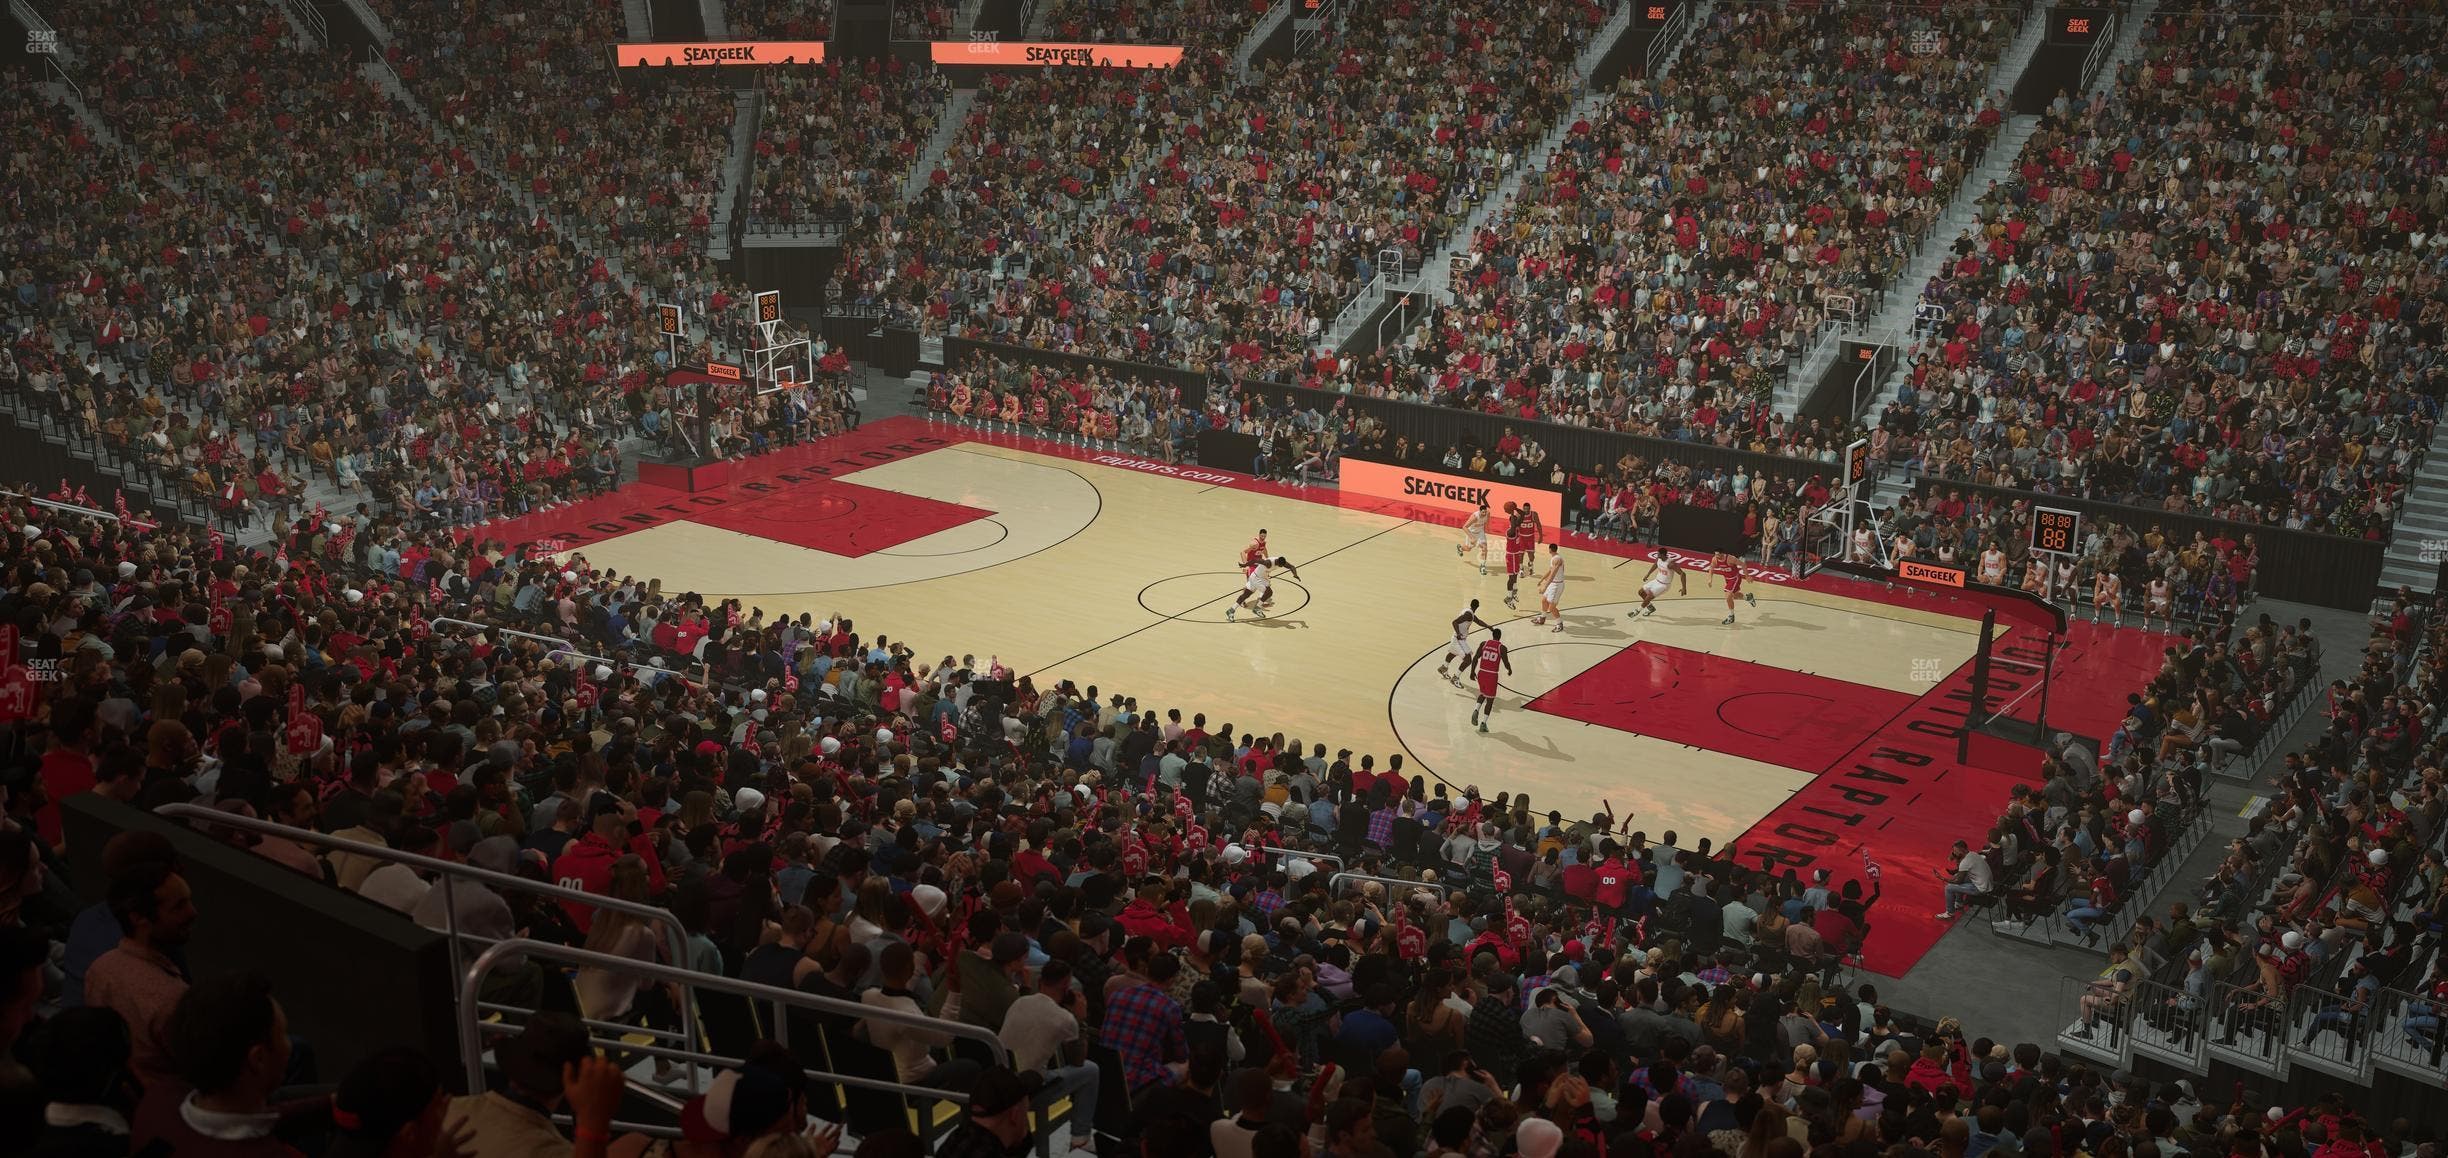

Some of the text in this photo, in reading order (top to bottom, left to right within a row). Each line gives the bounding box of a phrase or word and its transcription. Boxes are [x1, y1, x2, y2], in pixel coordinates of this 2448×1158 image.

[2066, 25, 2089, 33] GEEK
[683, 45, 755, 62] SEATGEEK
[763, 304, 776, 320] 88
[664, 317, 675, 332] 88
[710, 365, 737, 377] SEATGEEK
[739, 437, 948, 492] RAPTORS
[1092, 455, 1236, 484] raptors.com
[1403, 475, 1492, 508] SEATGEEK
[2041, 513, 2071, 528] 88 88
[2042, 527, 2066, 549] 88
[1647, 550, 1791, 583] @raors
[1906, 565, 1957, 583] SEATGEEK
[1482, 650, 1499, 662] 00
[1744, 746, 1934, 867] RAPTOR
[559, 877, 584, 891] 00
[1602, 877, 1616, 885] 00
